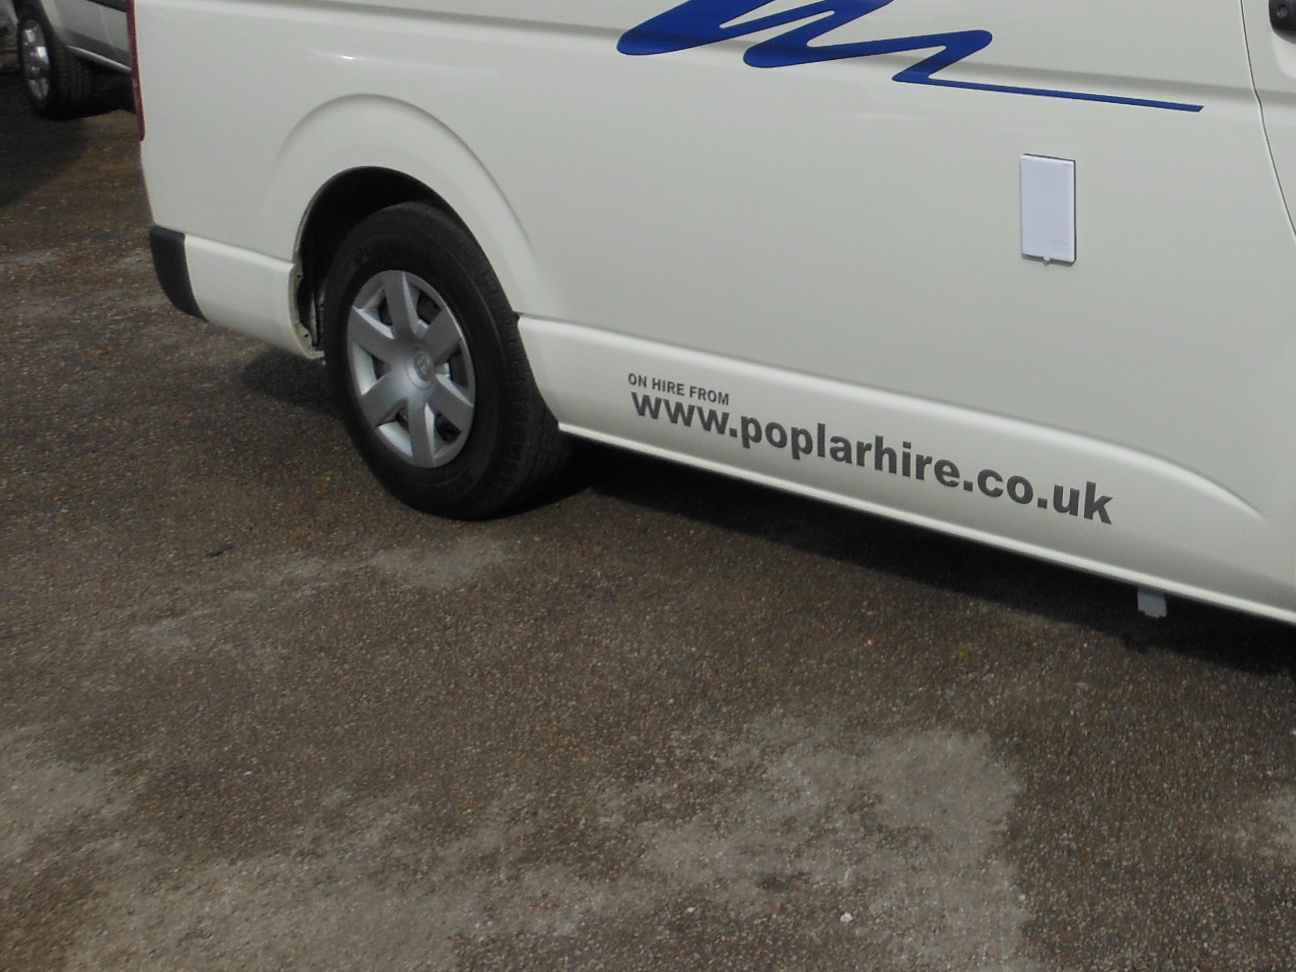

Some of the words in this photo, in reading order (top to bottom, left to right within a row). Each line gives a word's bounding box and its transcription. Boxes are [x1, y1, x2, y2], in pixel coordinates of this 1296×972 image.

[627, 373, 647, 388] ON
[651, 378, 685, 396] HIRE
[689, 386, 729, 406] FROM
[631, 391, 1113, 525] www.poplarhire.co.uk
